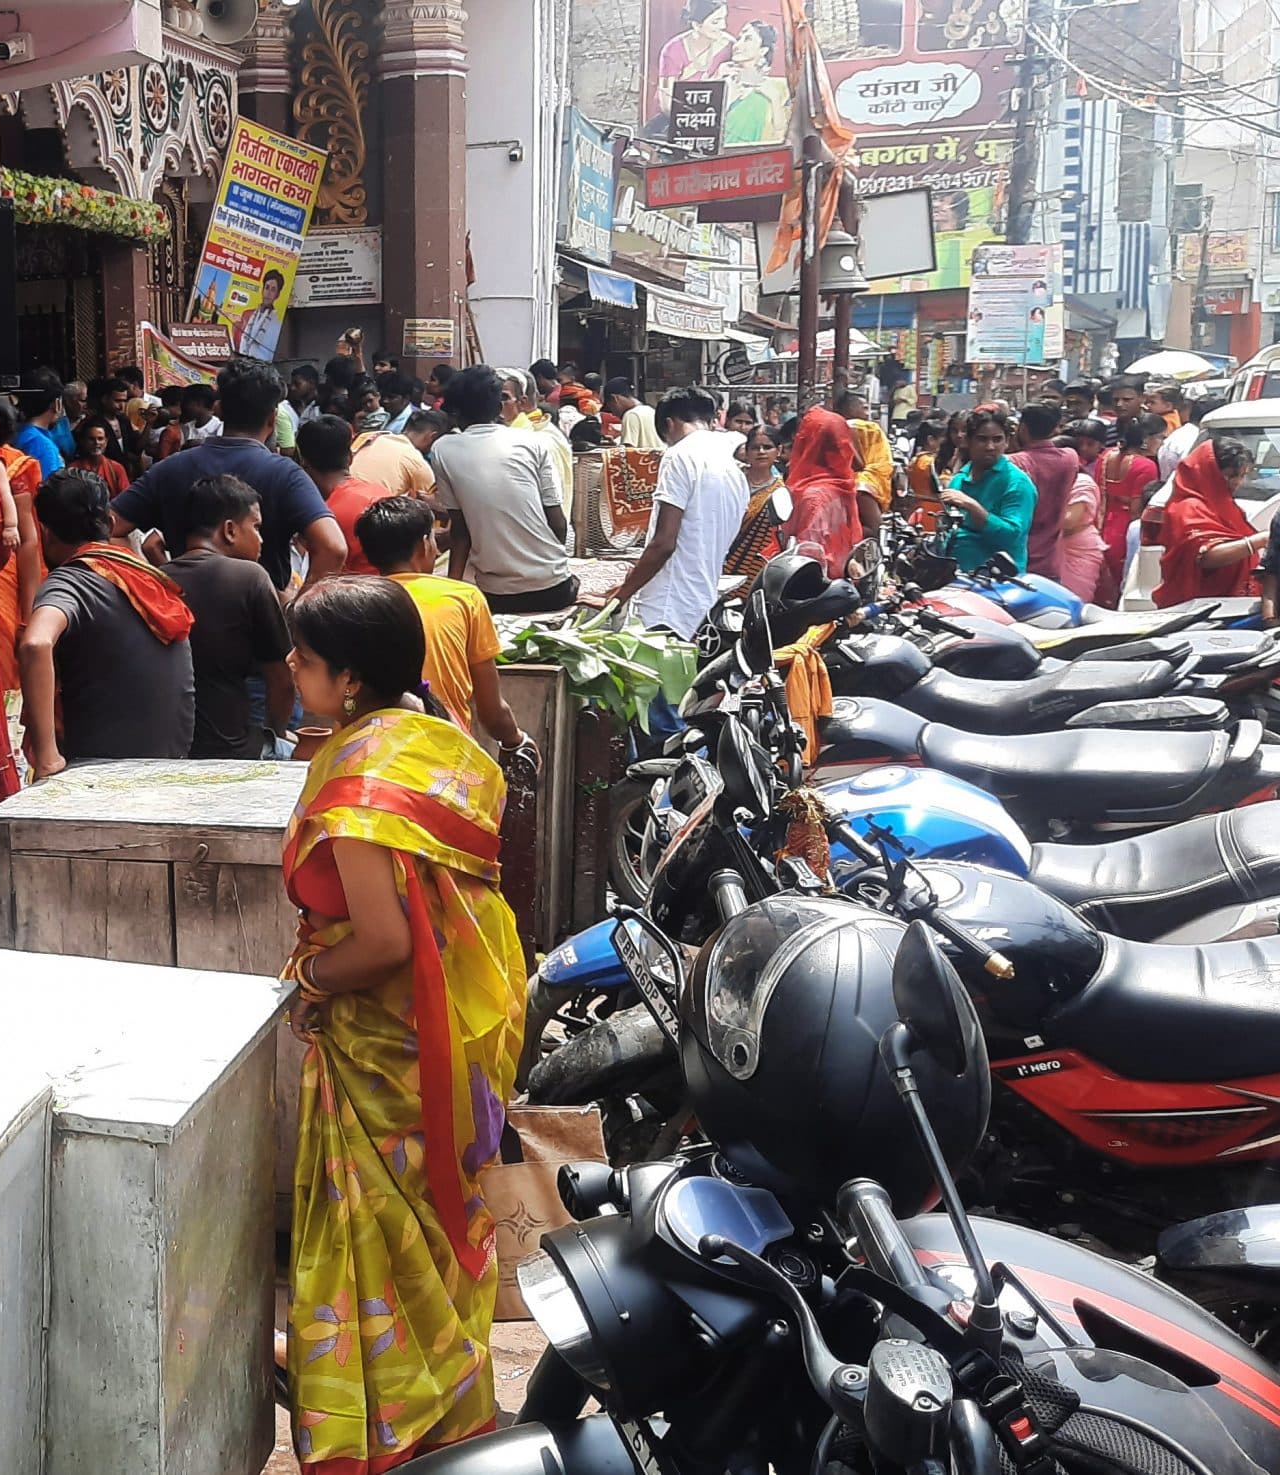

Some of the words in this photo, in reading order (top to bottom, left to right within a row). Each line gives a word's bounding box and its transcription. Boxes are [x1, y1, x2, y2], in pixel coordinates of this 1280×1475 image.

[858, 79, 920, 98] संजय
[928, 73, 958, 93] जी
[685, 90, 712, 105] राज
[913, 97, 945, 112] वाले
[676, 108, 717, 130] लक्ष्मी
[235, 129, 274, 166] निर्जला
[276, 148, 320, 185] एकादशी
[861, 144, 930, 167] बगल
[231, 160, 281, 193] भागवत
[283, 180, 313, 206] कथा
[652, 171, 669, 198] श्री
[674, 167, 740, 195] गरीबनाथ
[746, 158, 784, 186] मंदिर
[622, 942, 635, 961] BR
[1030, 1060, 1061, 1073] Hero
